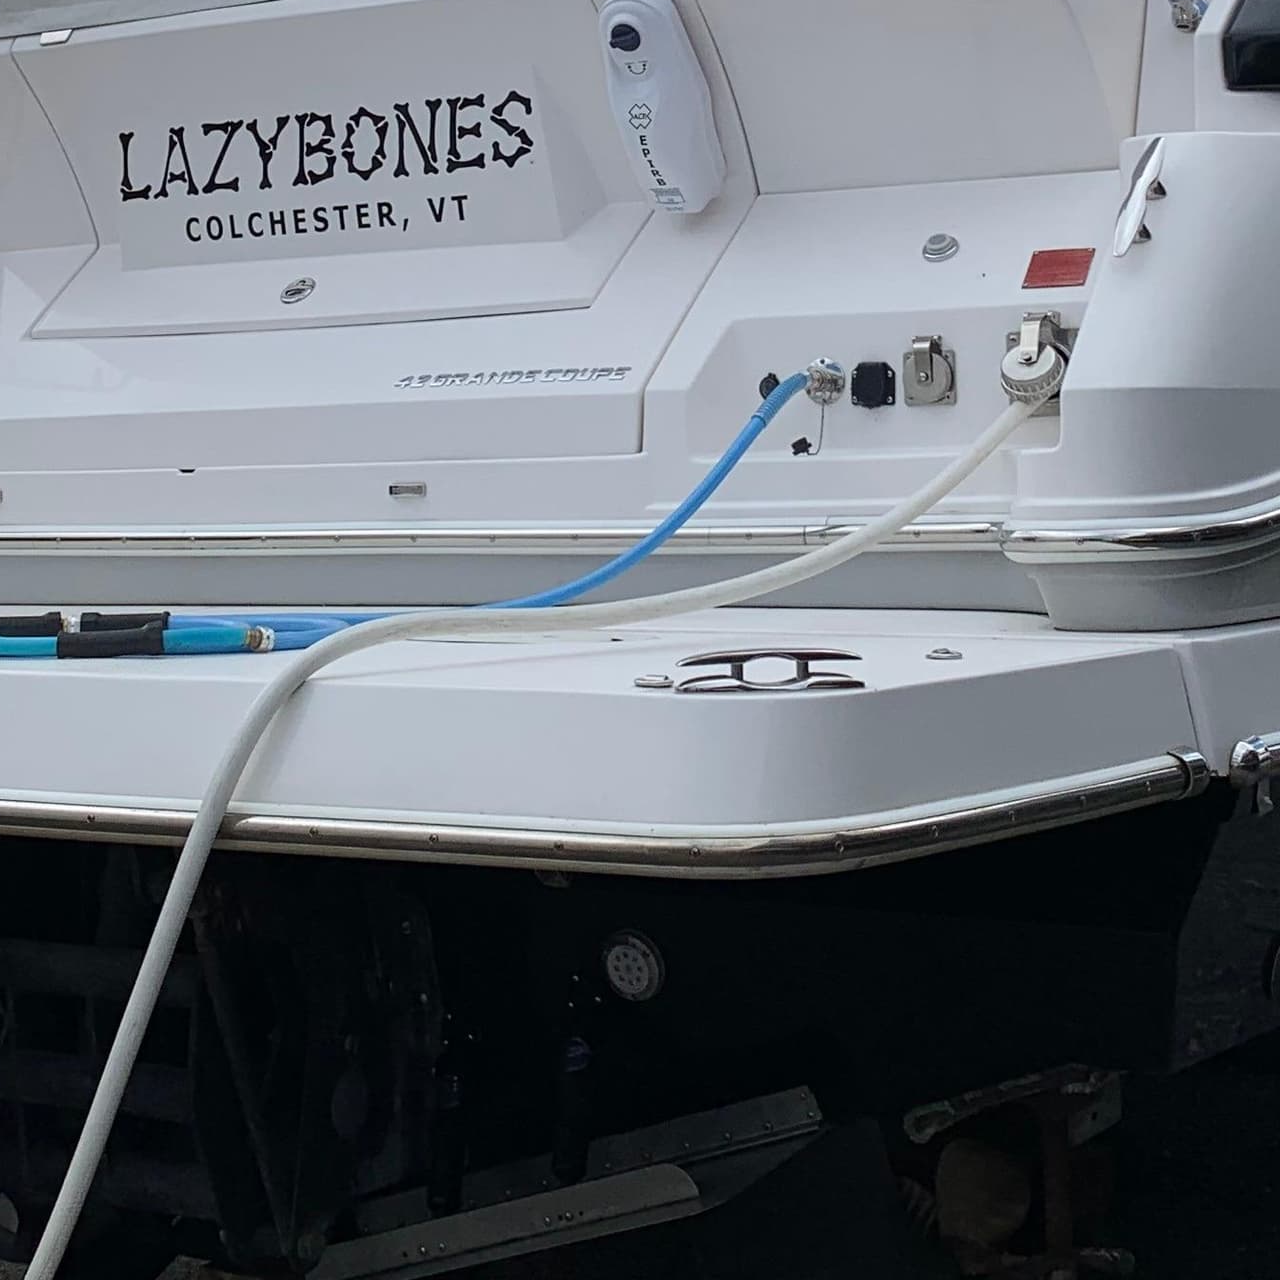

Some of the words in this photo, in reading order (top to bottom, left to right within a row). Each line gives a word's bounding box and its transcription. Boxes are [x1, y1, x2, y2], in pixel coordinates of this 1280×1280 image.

[119, 89, 534, 202] LAZYBONES
[639, 134, 667, 187] EPIRB
[185, 200, 410, 242] COLCHESTER,
[431, 194, 470, 223] VT
[393, 374, 432, 389] 42
[429, 369, 542, 388] GRANDE
[540, 366, 632, 383] COUPE
